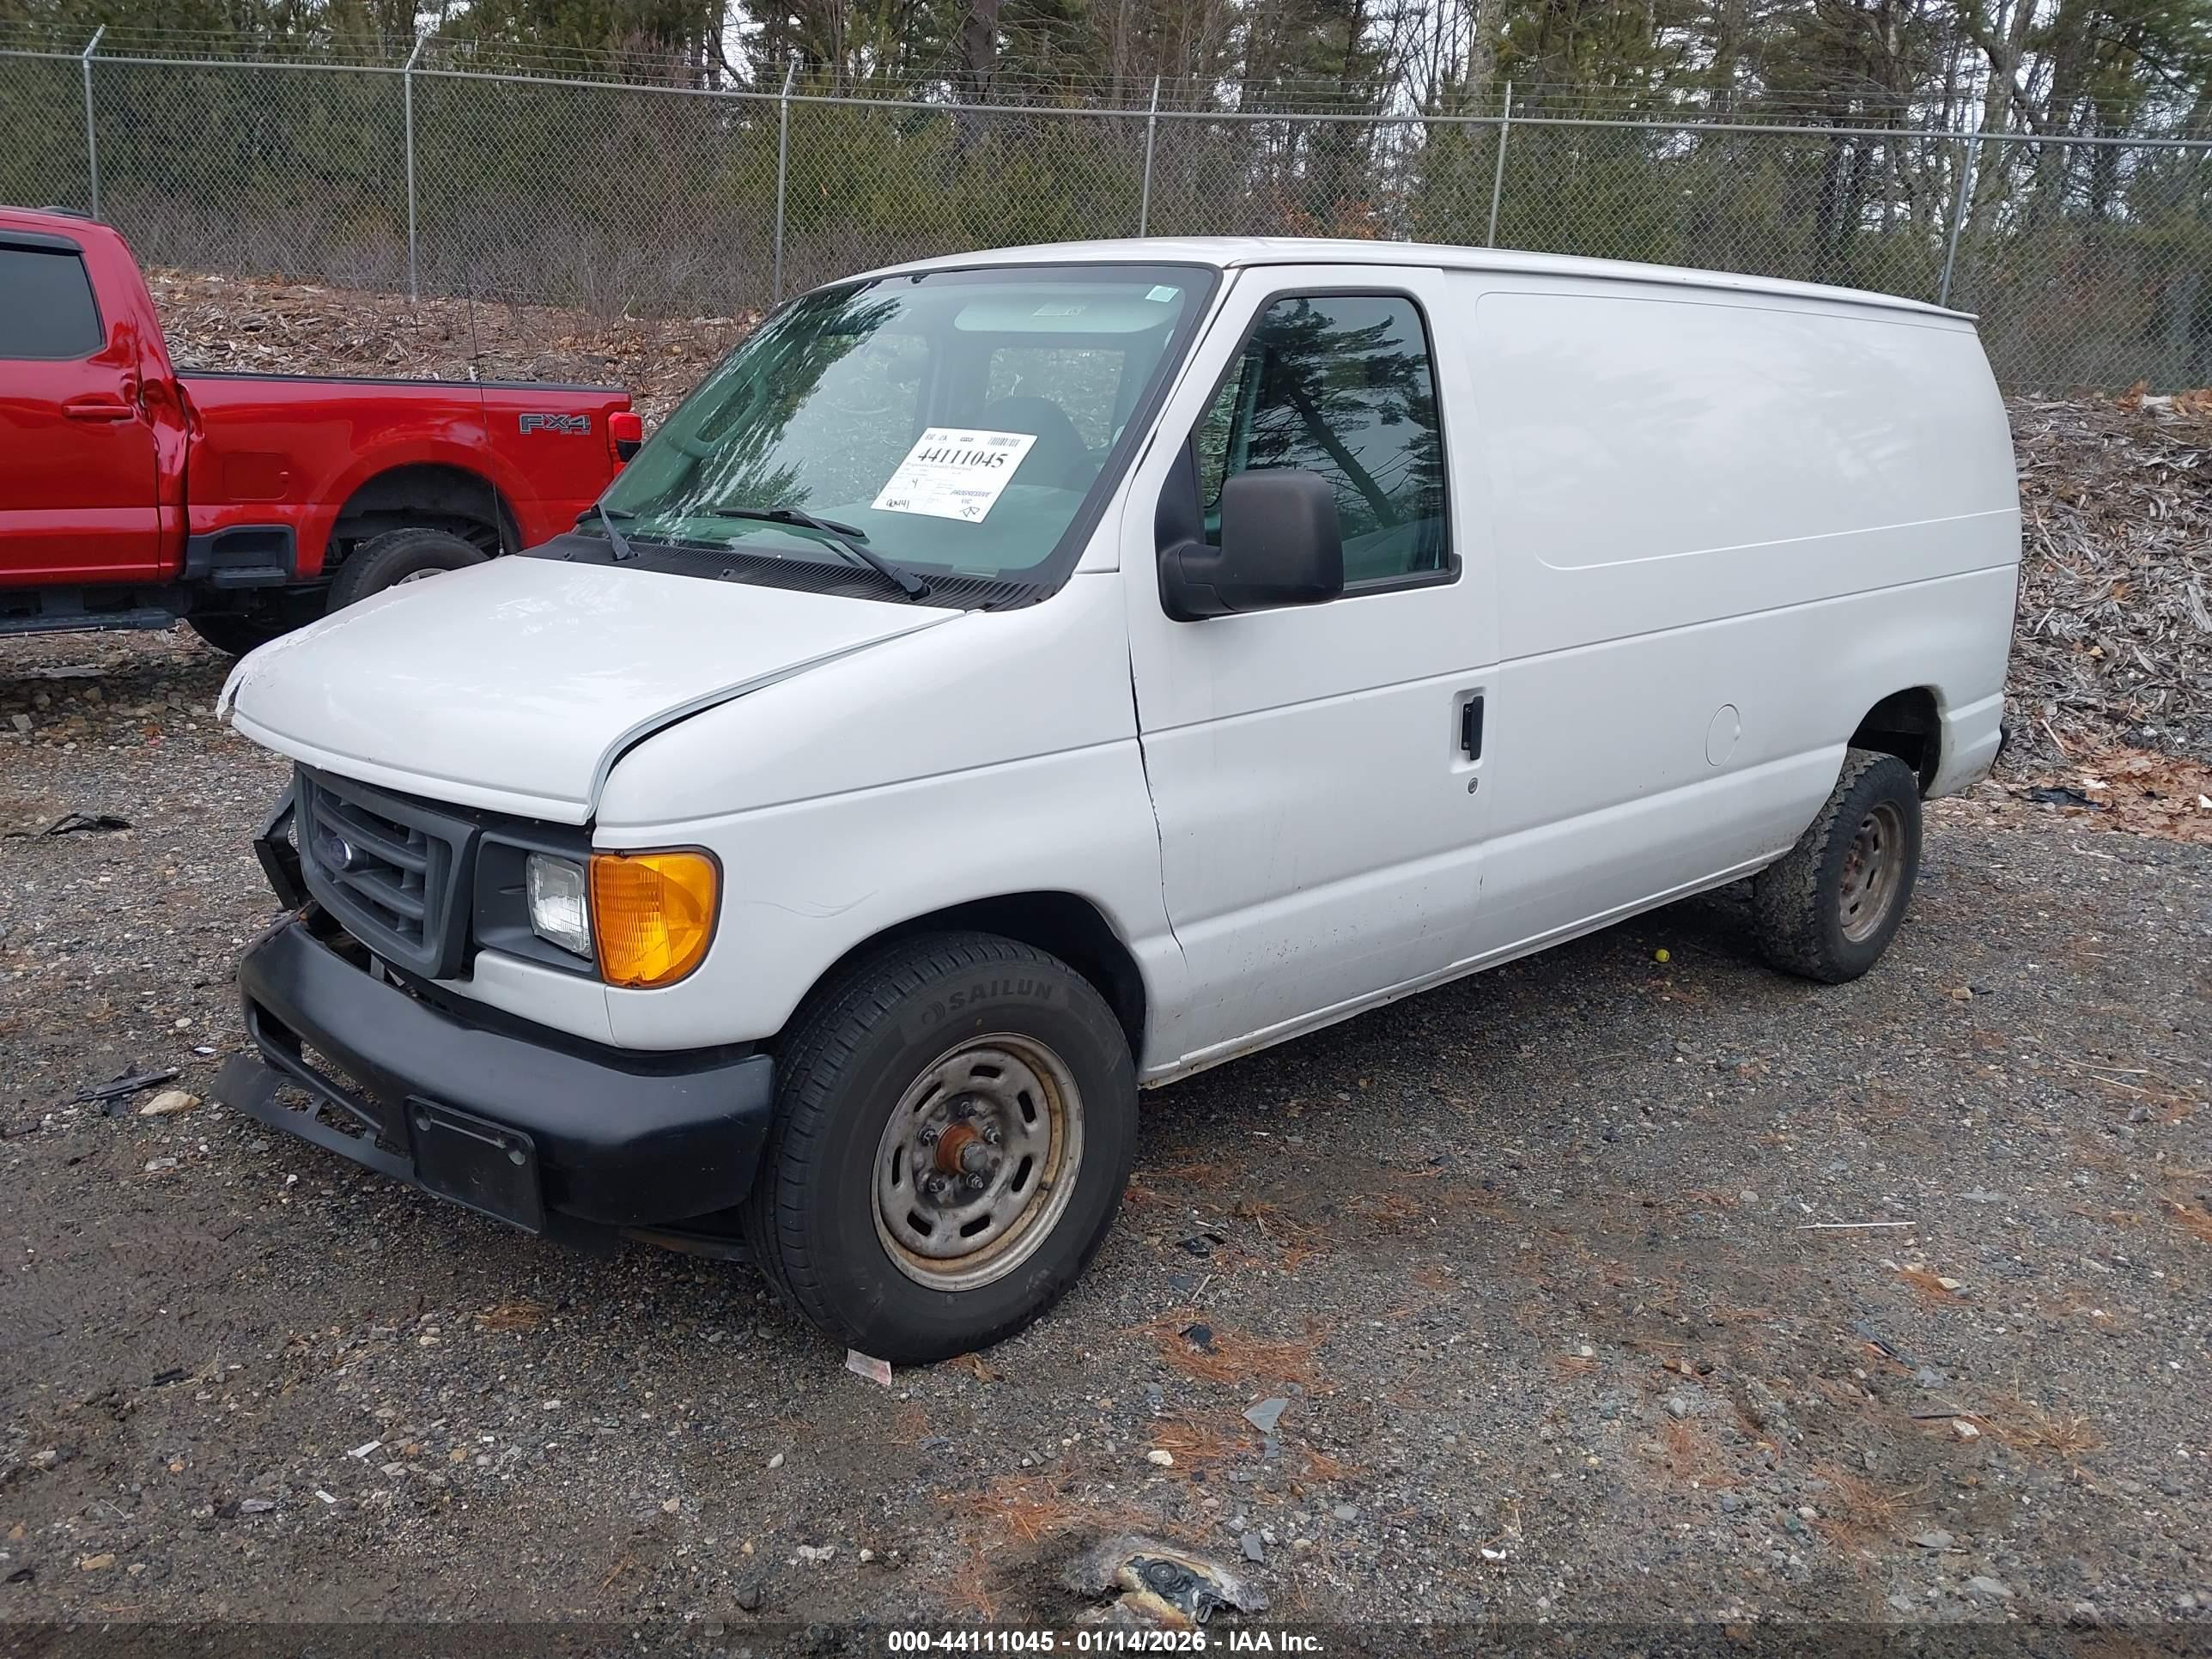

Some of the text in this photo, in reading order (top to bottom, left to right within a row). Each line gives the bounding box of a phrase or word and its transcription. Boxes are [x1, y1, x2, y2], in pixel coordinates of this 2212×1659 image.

[519, 412, 592, 434] FX4
[918, 447, 1009, 469] 44111045
[949, 979, 1054, 1011] SAILUN
